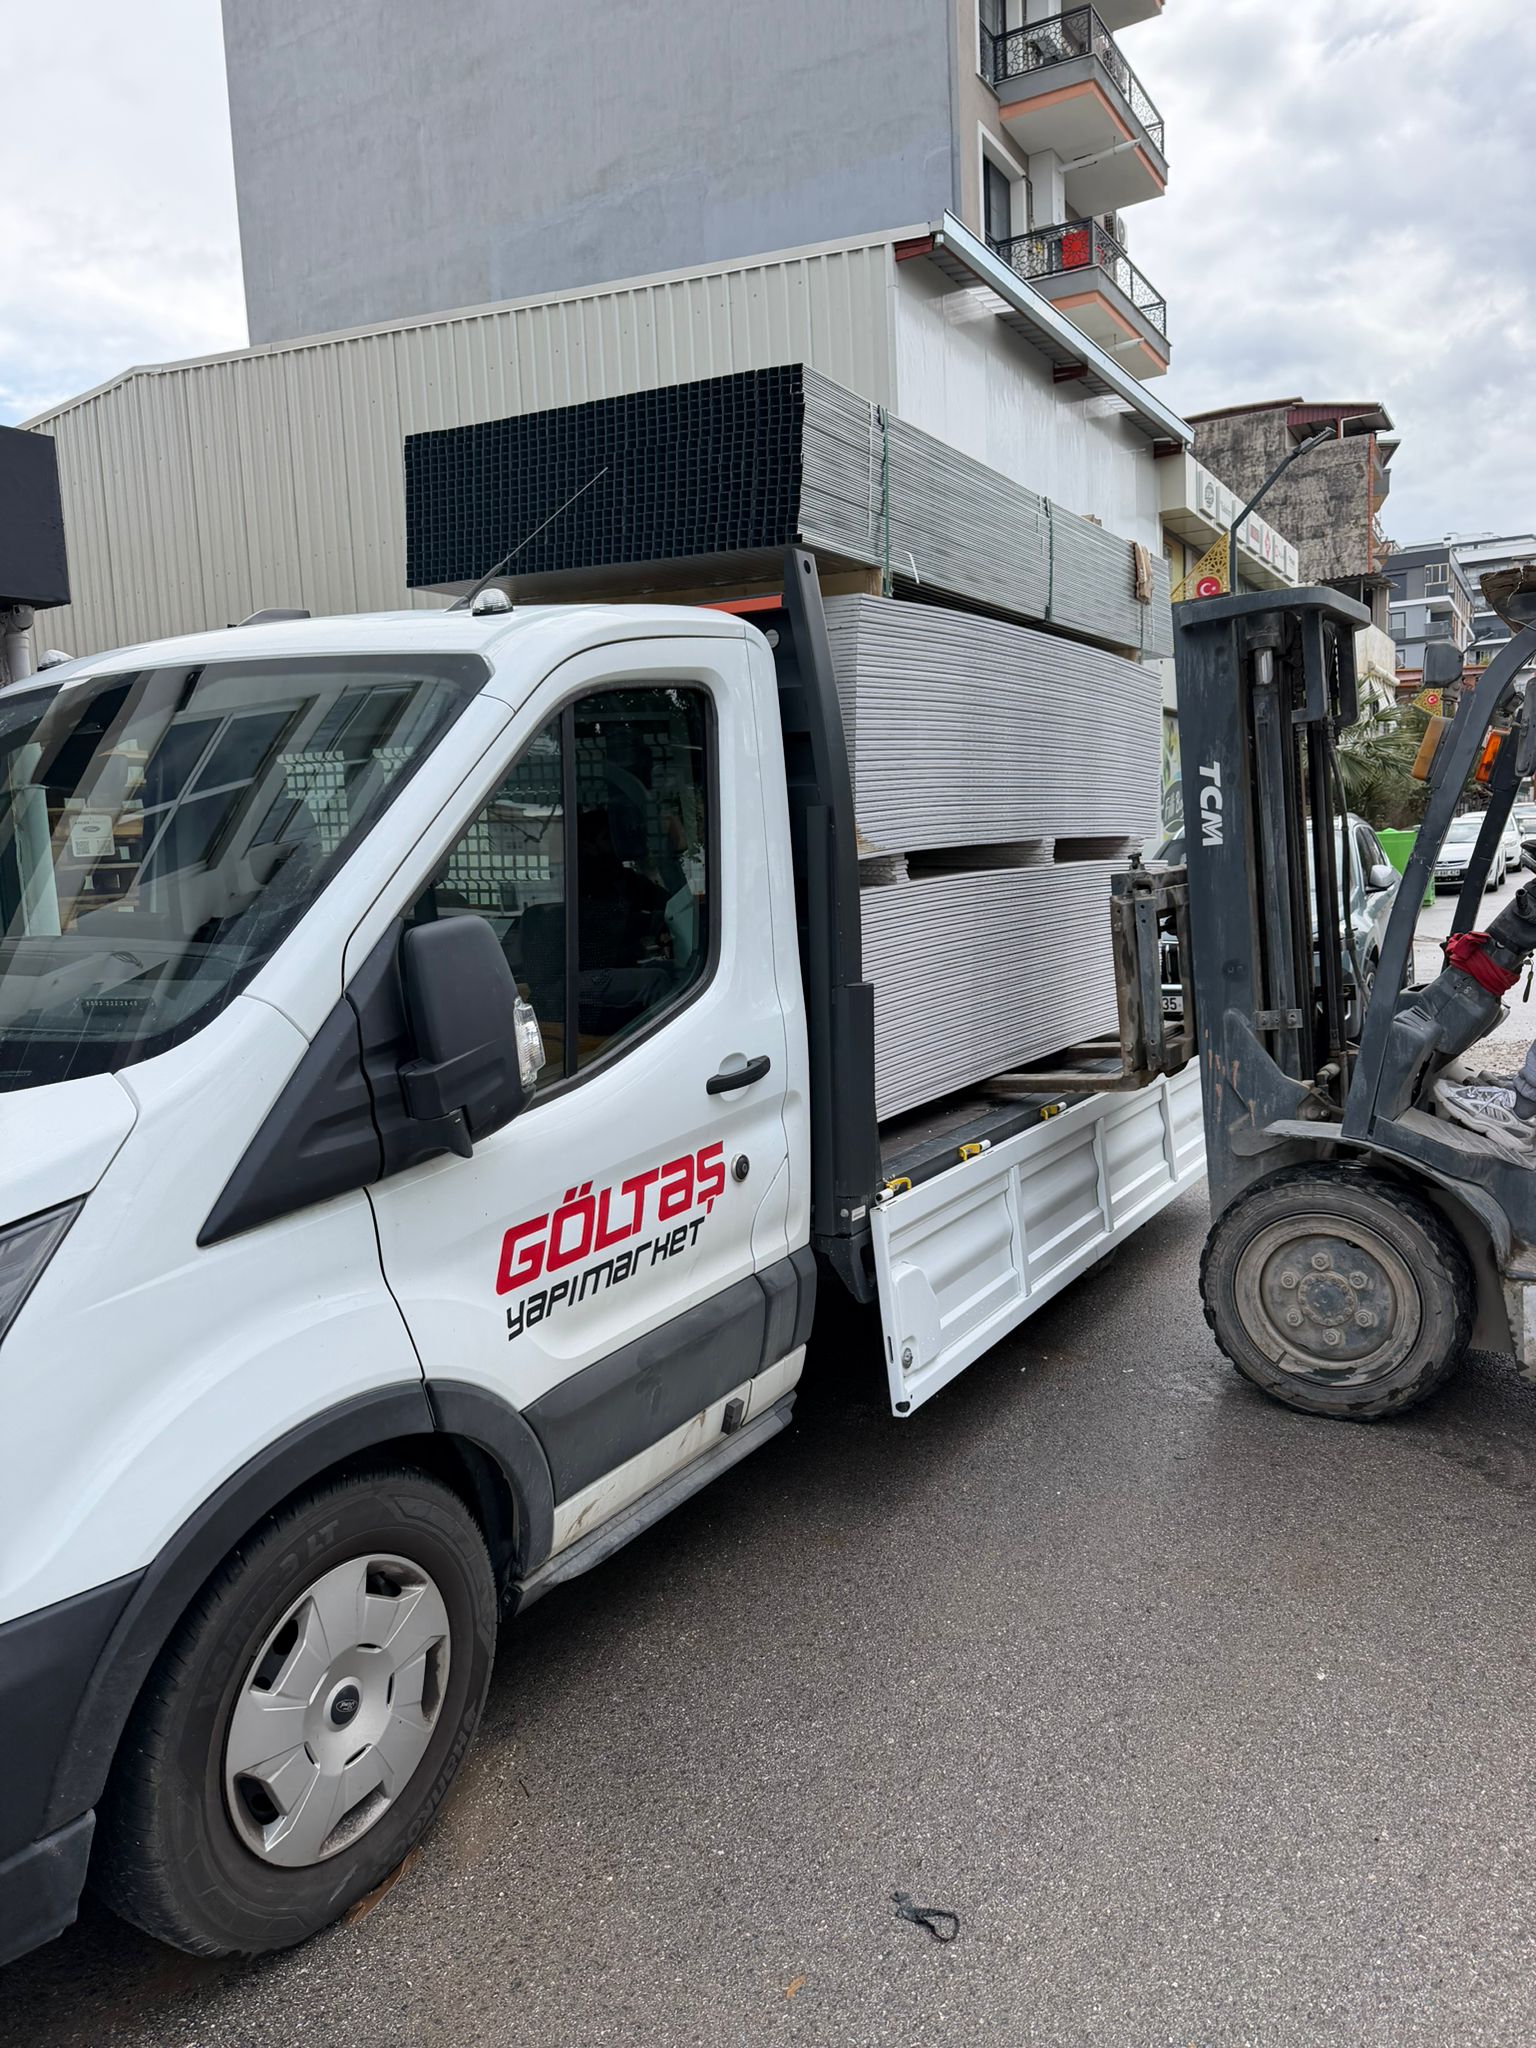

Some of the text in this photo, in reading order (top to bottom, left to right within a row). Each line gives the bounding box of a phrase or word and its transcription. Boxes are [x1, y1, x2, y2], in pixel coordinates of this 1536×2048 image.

[1199, 760, 1224, 847] TCM
[1161, 997, 1177, 1011] 35
[495, 1140, 726, 1296] GÖLTAŞ
